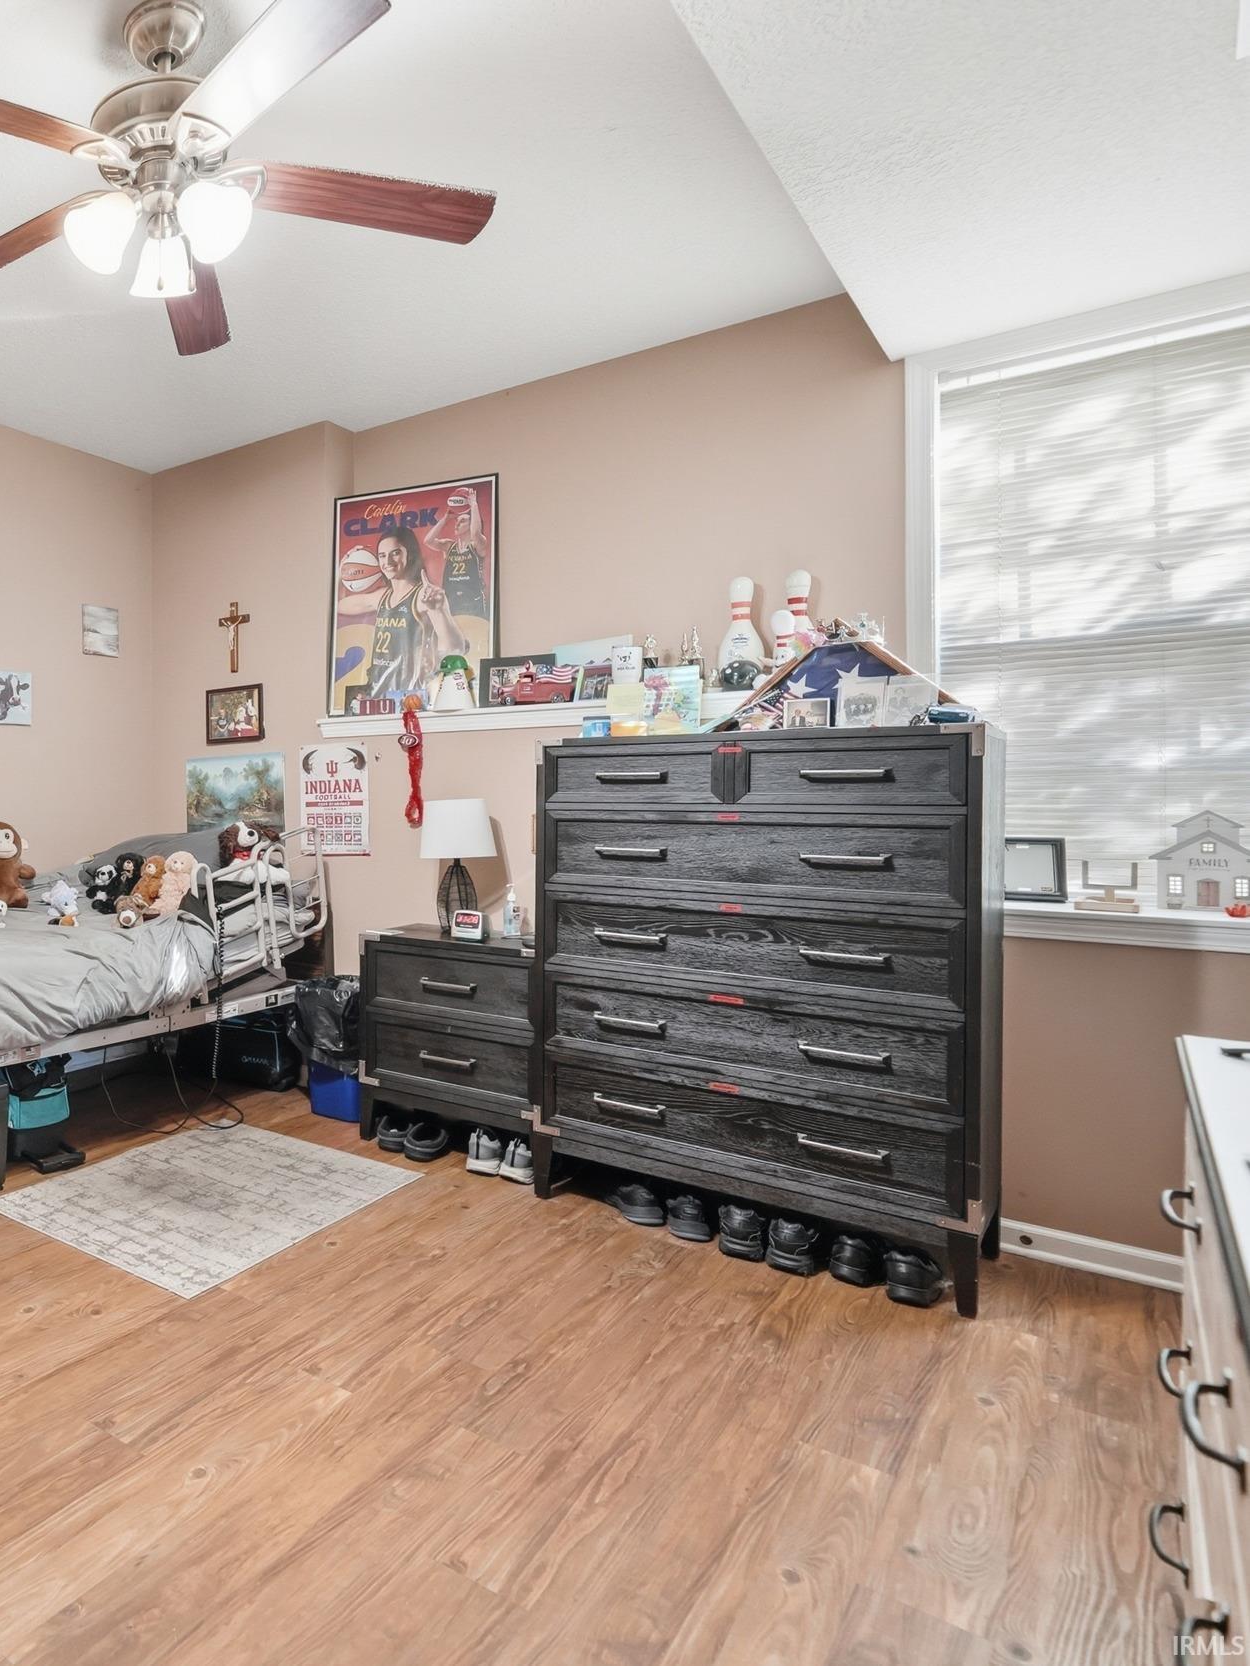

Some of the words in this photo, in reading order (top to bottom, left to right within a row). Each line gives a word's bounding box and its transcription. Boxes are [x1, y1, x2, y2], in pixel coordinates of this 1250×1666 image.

[364, 500, 407, 520] Caitlin
[344, 507, 440, 537] CLARK
[452, 563, 466, 575] 22
[376, 631, 392, 653] 22
[305, 779, 363, 794] INDIANA
[1189, 858, 1229, 868] FAMILY
